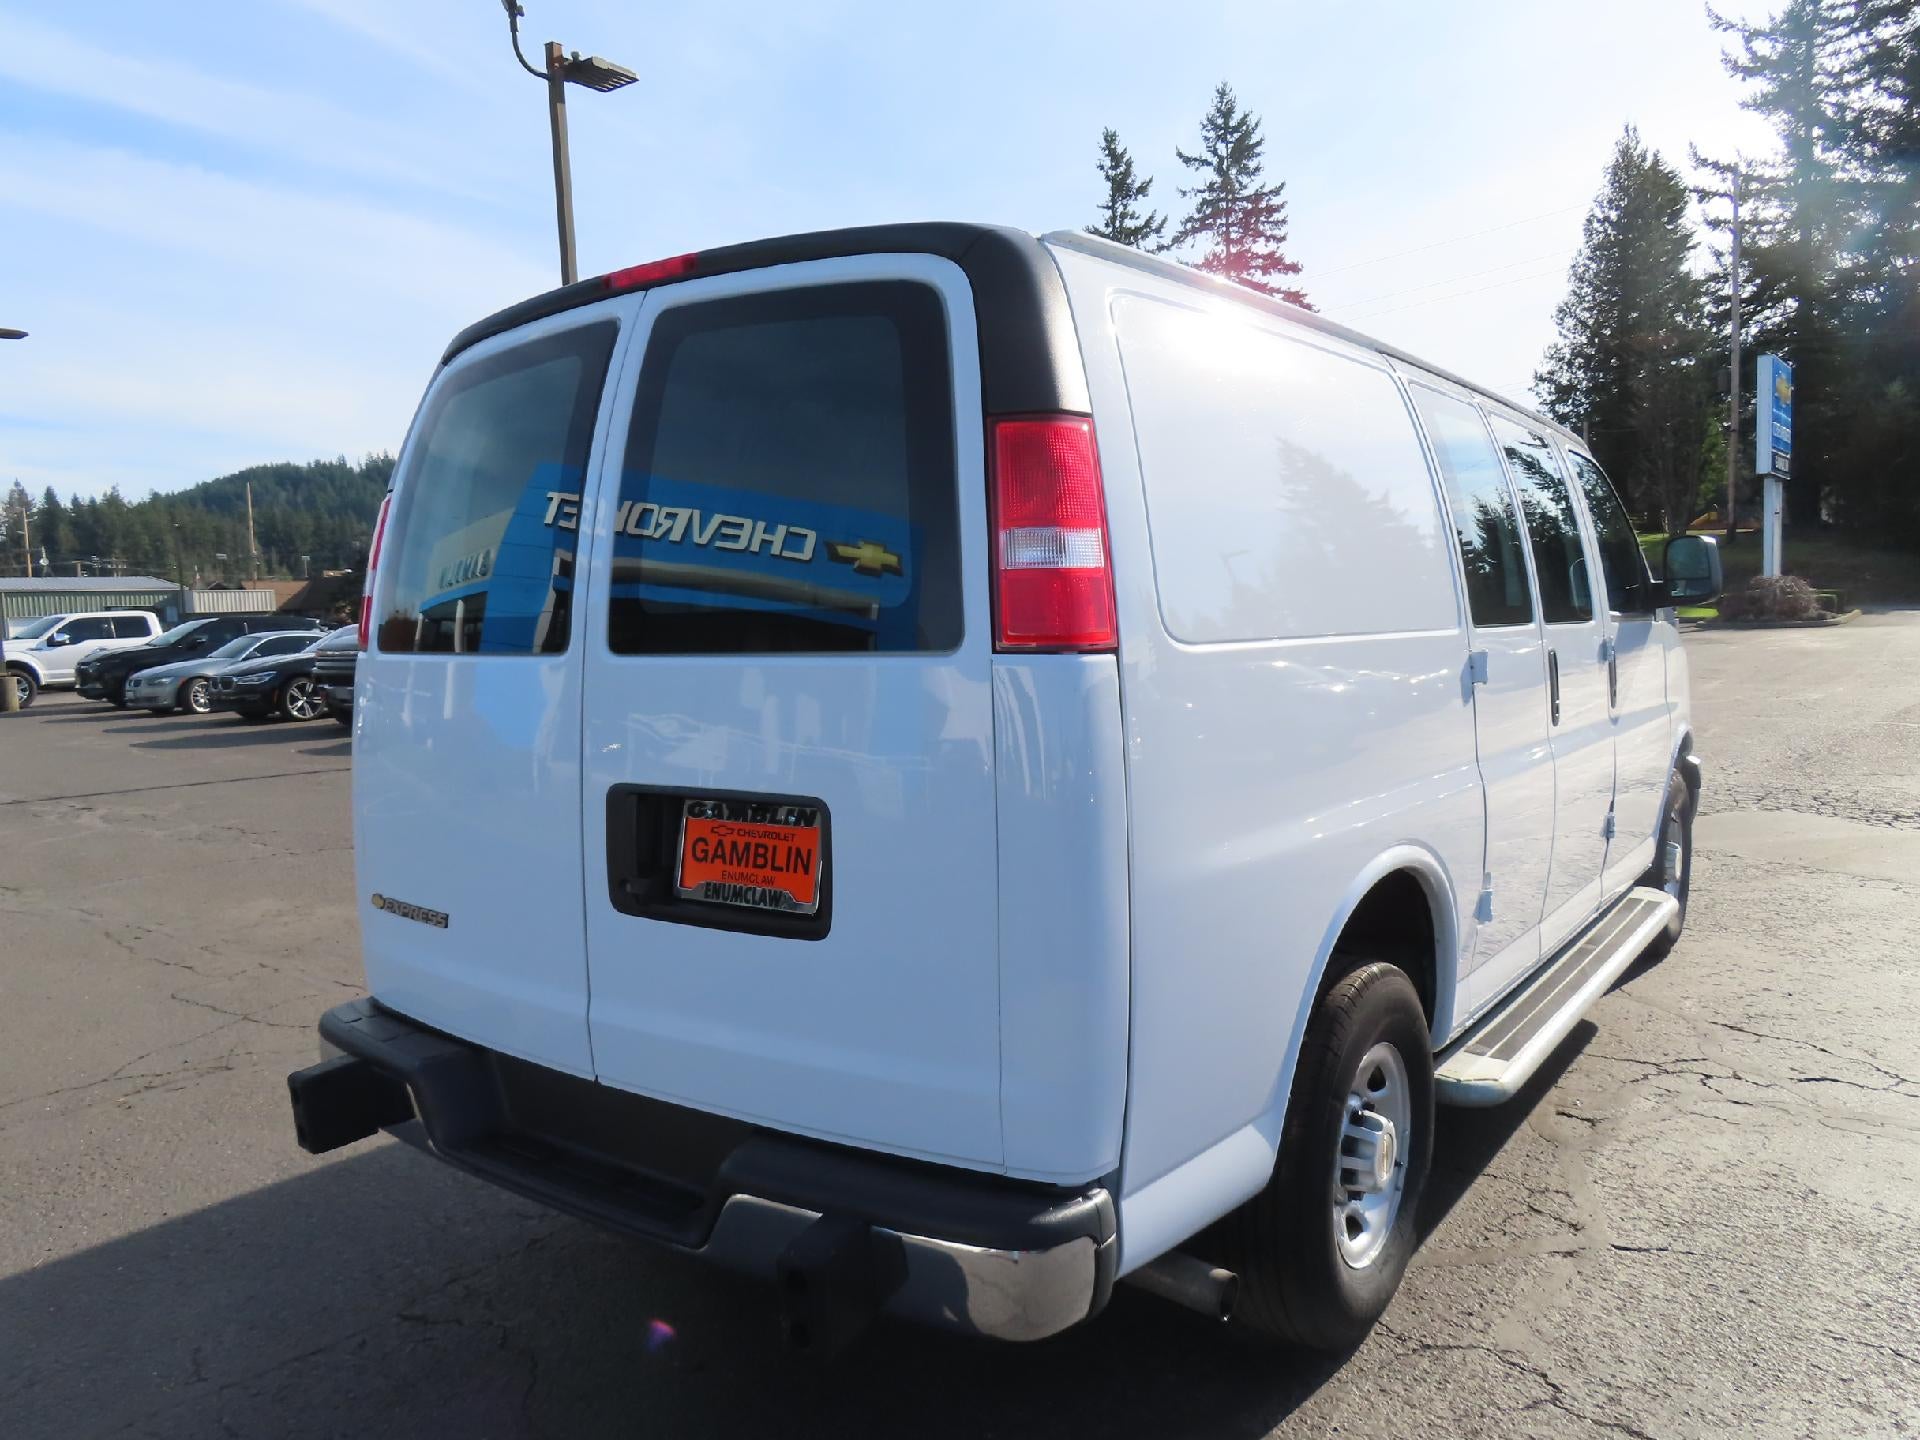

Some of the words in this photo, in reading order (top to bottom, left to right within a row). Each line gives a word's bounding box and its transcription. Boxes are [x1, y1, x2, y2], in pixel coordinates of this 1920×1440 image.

[737, 828, 797, 842] CHEVROLET
[691, 837, 812, 875] GAMBLIN
[721, 870, 776, 886] ENUMCLAW
[703, 881, 782, 908] ENUMCLAW
[383, 897, 448, 928] EXPRESS
